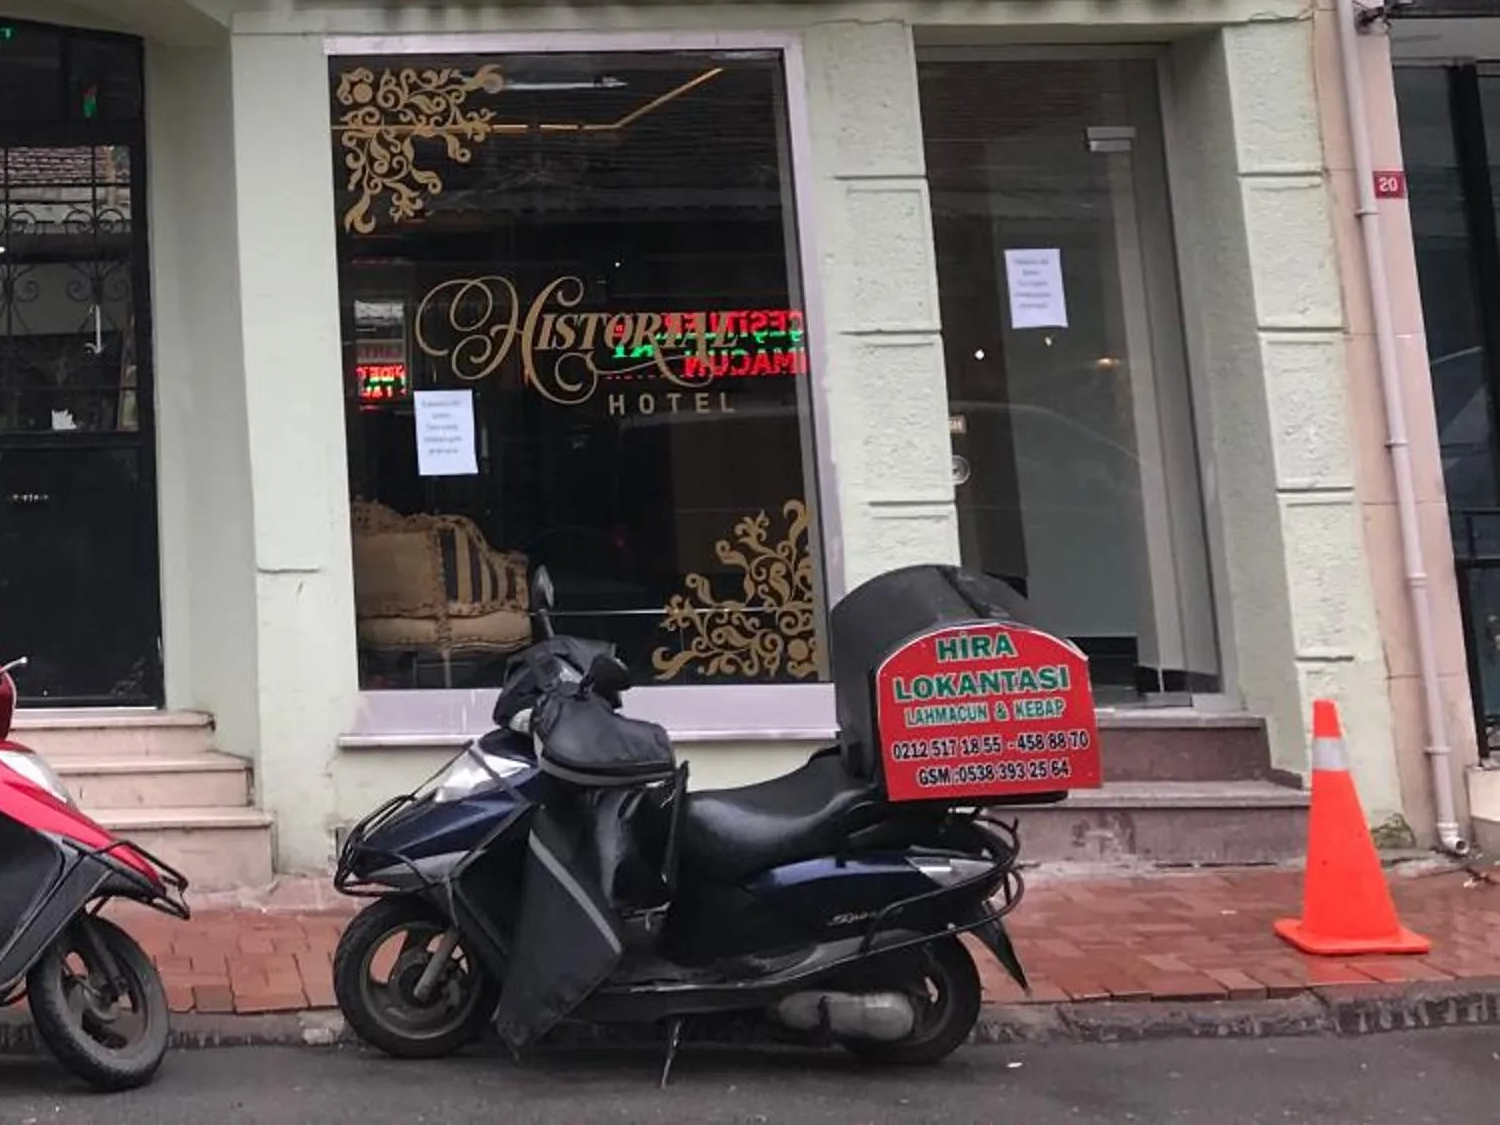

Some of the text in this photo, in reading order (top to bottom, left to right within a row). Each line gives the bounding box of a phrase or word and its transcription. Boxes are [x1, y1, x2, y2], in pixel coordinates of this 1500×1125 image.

[1379, 177, 1399, 192] 20
[609, 392, 736, 416] HOTEL
[894, 667, 1069, 702] LOKANTASI
[906, 699, 1066, 726] LAHMACUN & KEBAP
[893, 742, 928, 760] 0212
[932, 740, 956, 757] 517
[962, 738, 980, 755] 18
[983, 737, 1000, 753] 55
[1018, 734, 1045, 750] 458
[1049, 733, 1067, 749] 88
[1071, 731, 1088, 748] 70
[919, 767, 949, 786] GSM
[1000, 762, 1024, 780] 393
[1029, 762, 1046, 778] 25
[1051, 760, 1069, 776] 64
